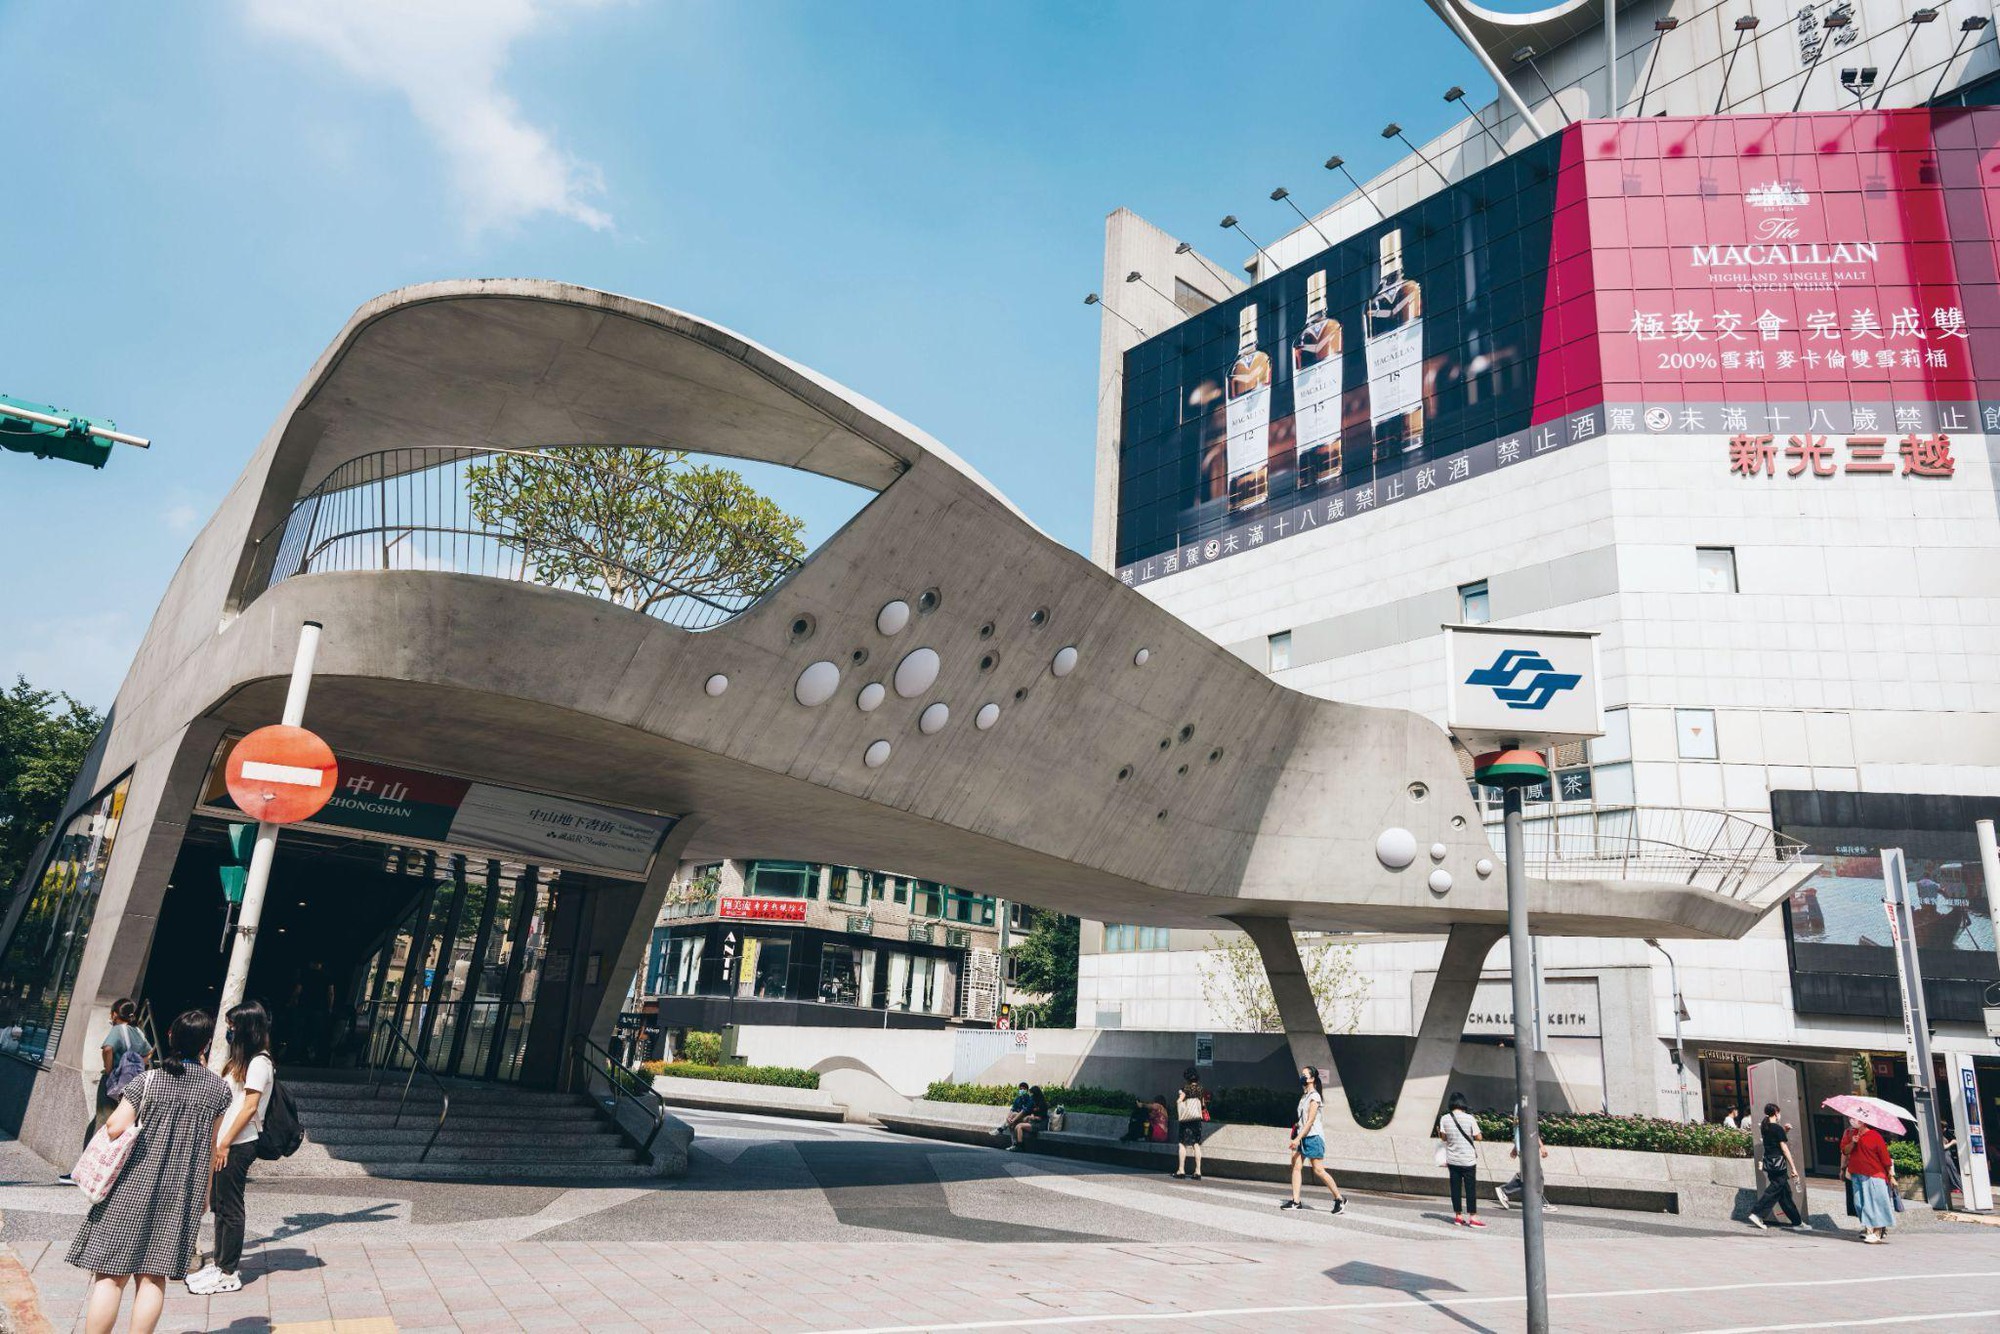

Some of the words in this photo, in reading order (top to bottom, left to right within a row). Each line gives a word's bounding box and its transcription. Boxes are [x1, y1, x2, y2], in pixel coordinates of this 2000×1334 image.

[1754, 217, 1800, 241] The
[1690, 241, 1879, 267] MACALLAN
[1708, 272, 1777, 282] HIGHLAND
[1783, 271, 1828, 281] SINGLE
[1834, 271, 1867, 281] MALT
[1737, 282, 1788, 293] SCOTCH
[1793, 281, 1841, 292] WHISKY
[1629, 309, 1788, 342] 極致交會
[1805, 307, 1970, 341] 完美成雙
[1776, 348, 1948, 370] 麥卡倫雙雪莉桶
[1313, 402, 1325, 414] 15
[1243, 430, 1255, 442] 12
[1729, 433, 1956, 478] 新光三越
[1120, 548, 1199, 585] 禁止酒駕
[1223, 454, 1471, 553] 未滿十八歲禁止飲酒
[346, 775, 409, 803] 中山
[327, 797, 411, 817] ZHONGSHAN
[1468, 1013, 1516, 1024] CHARLE
[1548, 1014, 1586, 1024] KEITH
